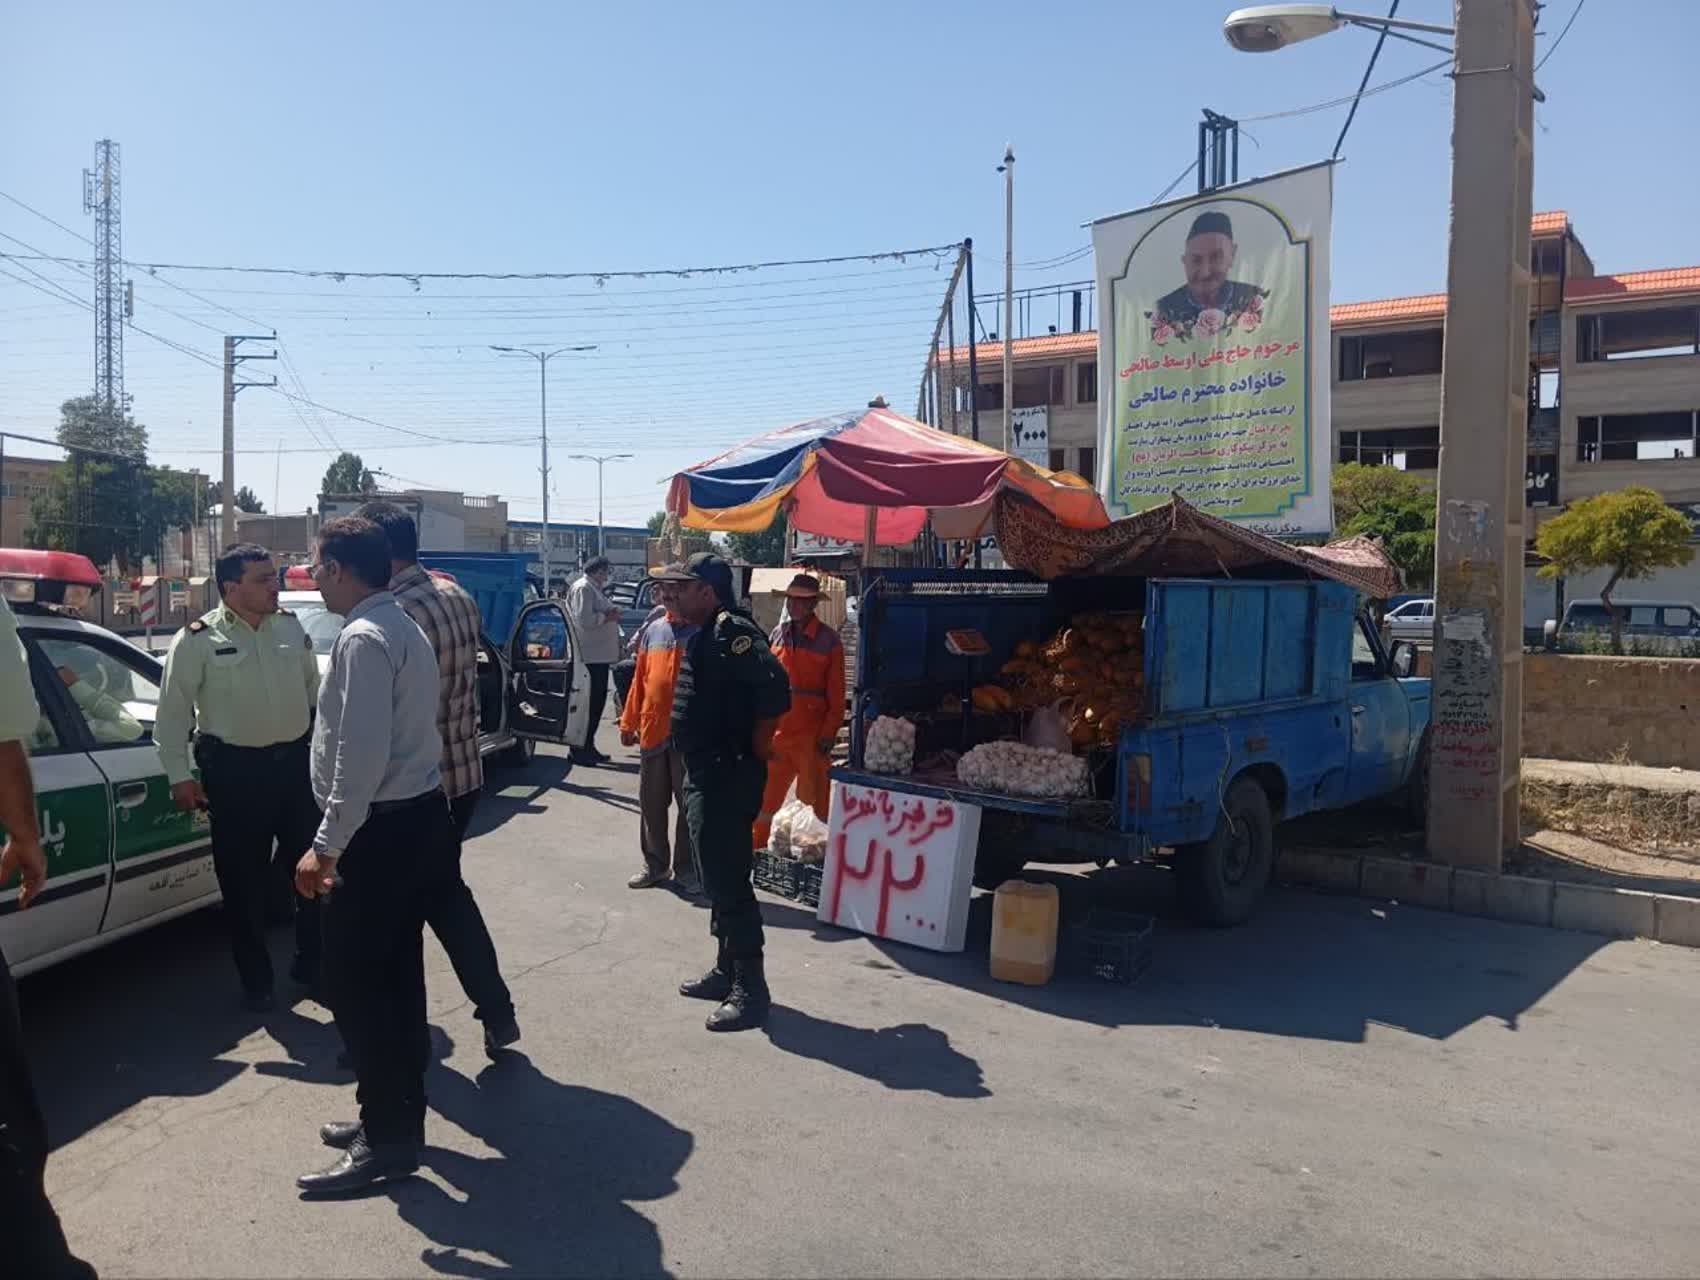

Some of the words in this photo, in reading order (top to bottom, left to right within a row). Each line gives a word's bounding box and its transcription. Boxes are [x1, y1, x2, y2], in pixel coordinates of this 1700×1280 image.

[1226, 347, 1251, 365] حاج
[1253, 340, 1300, 359] مرحوم
[1120, 359, 1159, 378] صالحی
[1163, 351, 1197, 371] اوسط
[1198, 350, 1224, 370] علی
[1230, 370, 1286, 395] خانواده
[1128, 385, 1177, 409] صالحی
[1182, 383, 1225, 403] محترم
